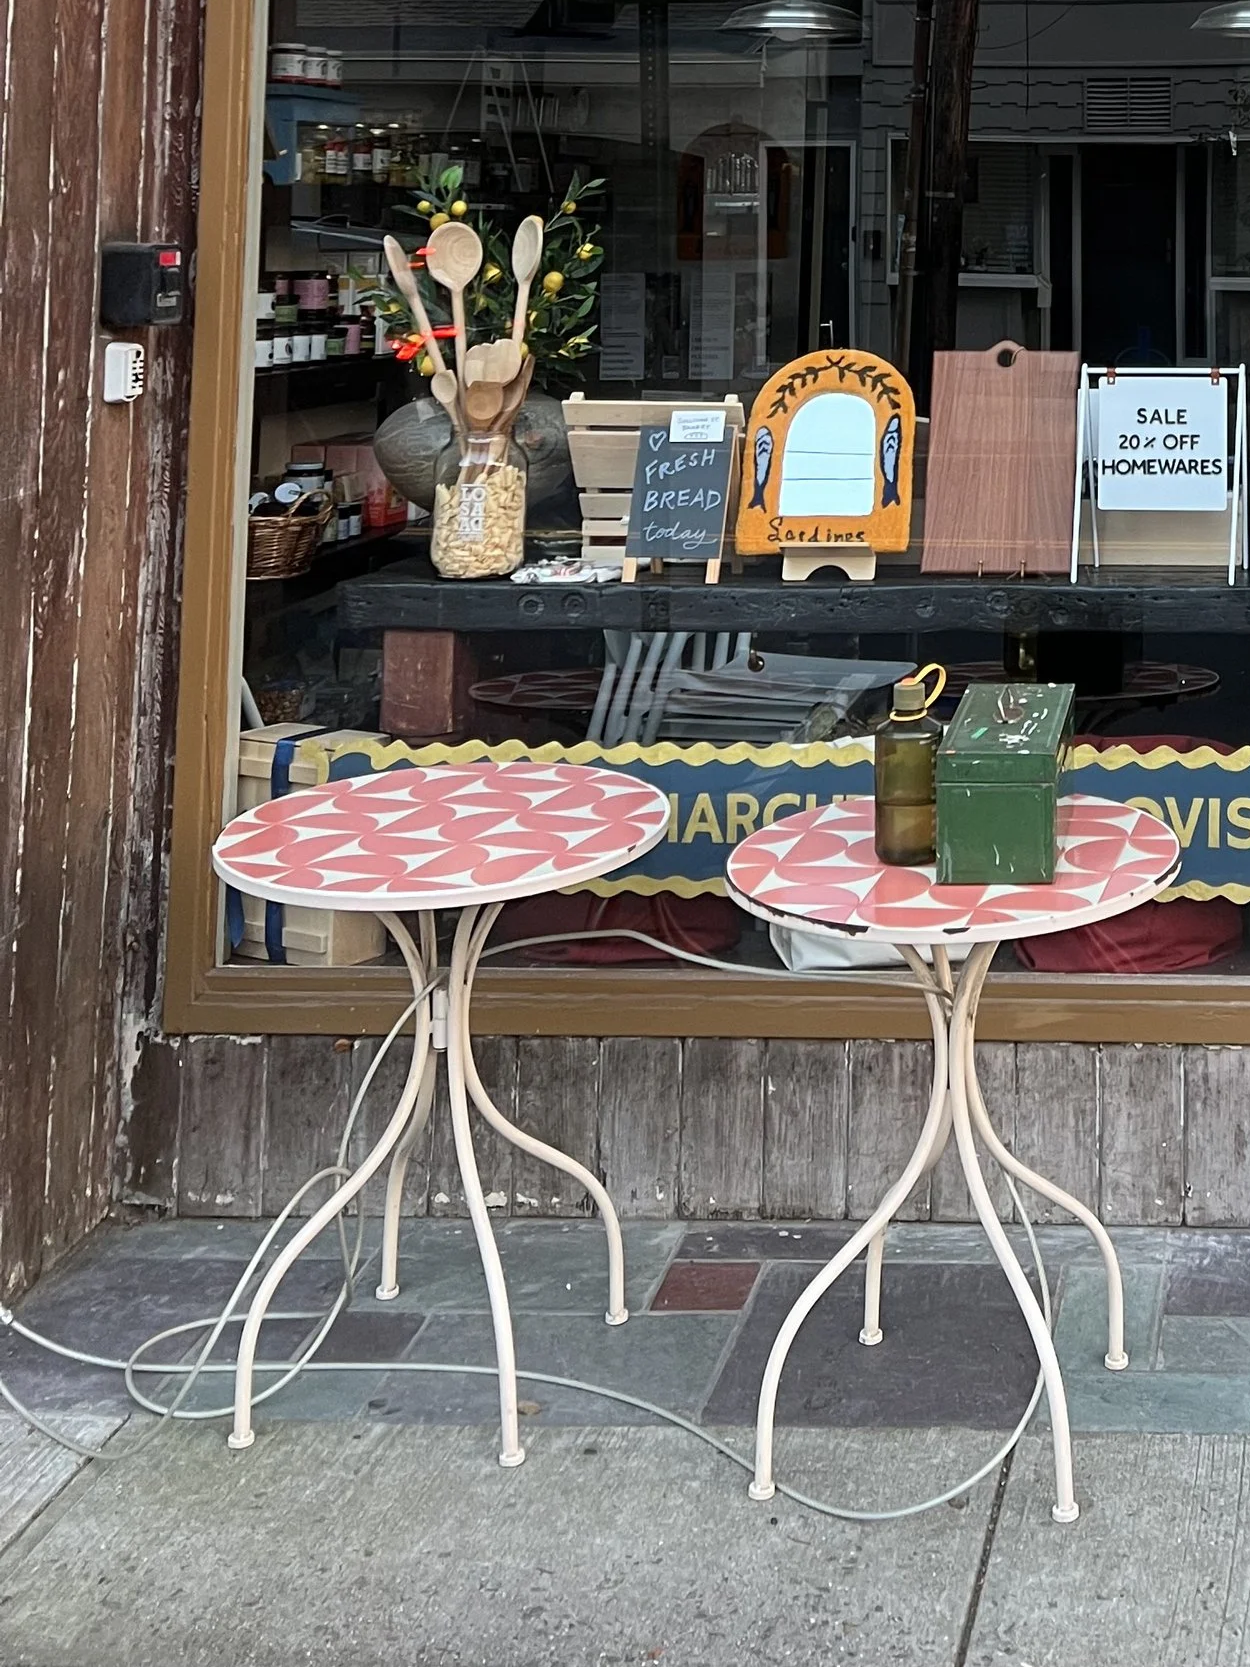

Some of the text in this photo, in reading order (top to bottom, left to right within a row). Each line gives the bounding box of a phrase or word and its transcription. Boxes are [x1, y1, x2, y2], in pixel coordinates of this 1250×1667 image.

[1136, 407, 1188, 425] SALE
[1118, 434, 1201, 451] 20% OFF
[644, 448, 716, 485] FRESH
[1101, 458, 1223, 476] HOMEWARES
[643, 488, 722, 512] BREAD
[643, 522, 719, 549] today
